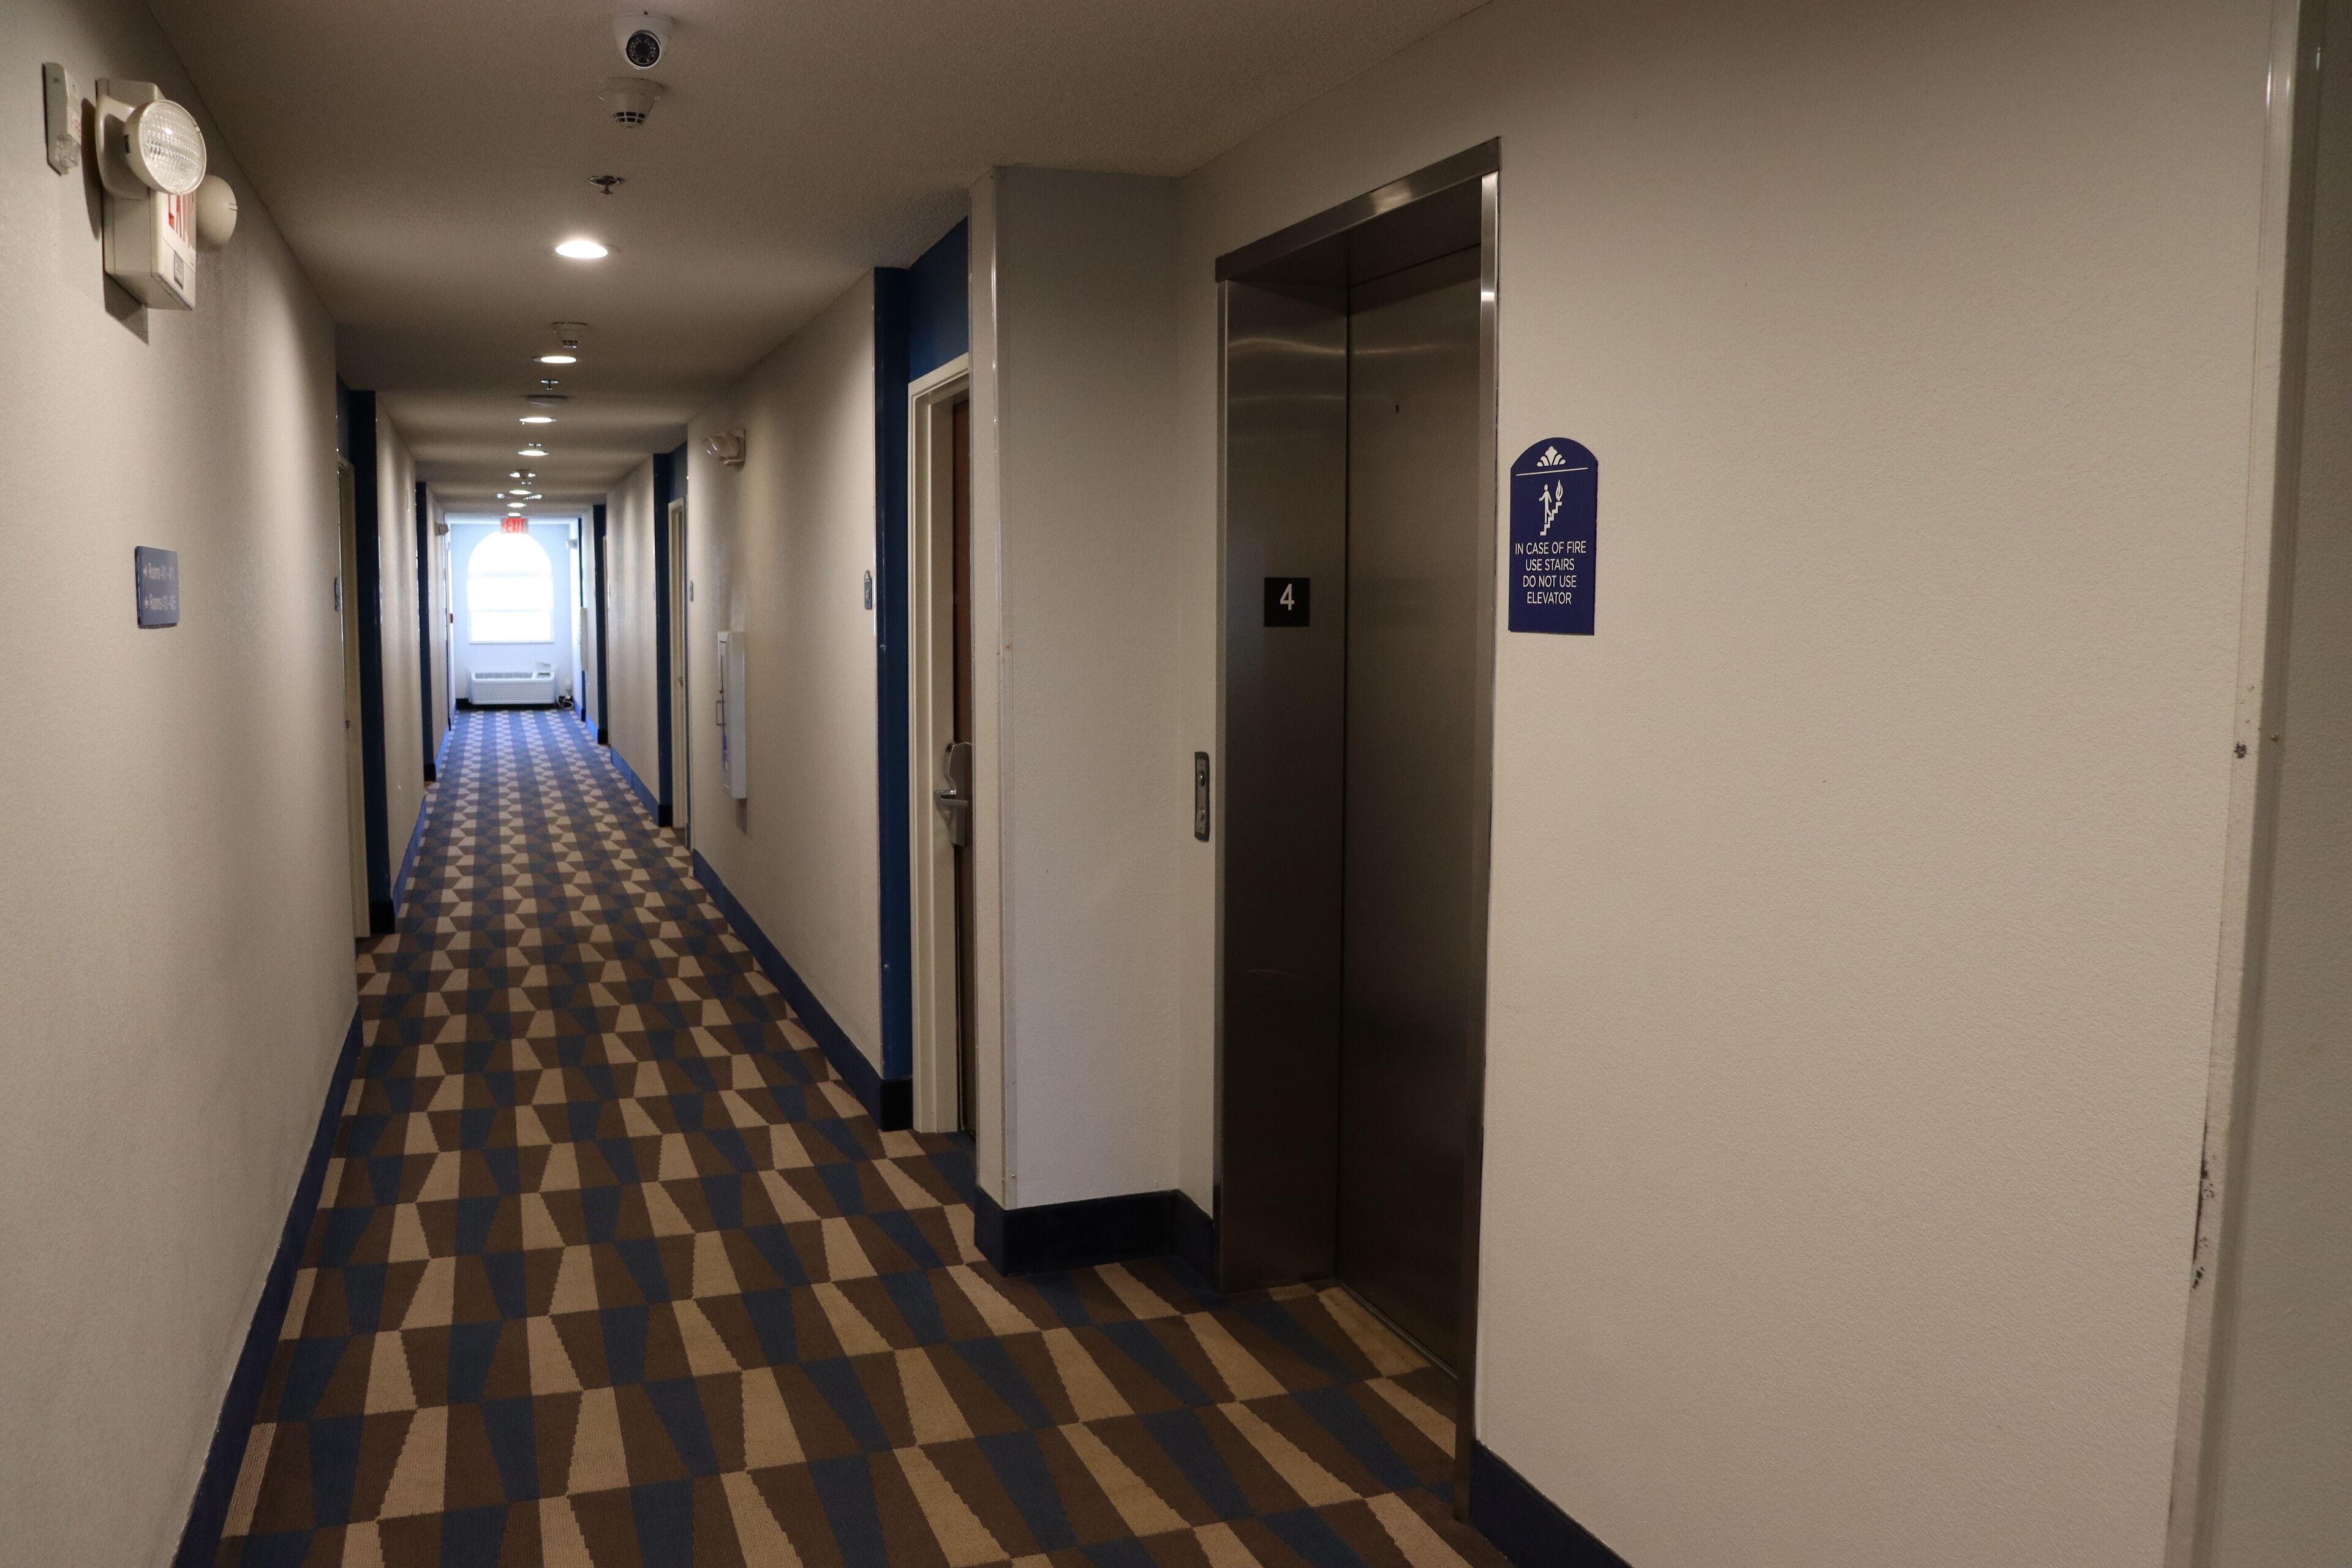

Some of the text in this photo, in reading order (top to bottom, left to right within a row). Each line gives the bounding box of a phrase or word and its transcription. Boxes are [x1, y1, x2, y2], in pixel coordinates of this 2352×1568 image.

[505, 518, 525, 532] EXIT
[1515, 540, 1587, 555] IN CASE OF FIRE
[1525, 558, 1575, 571] USE STAIRS
[1523, 575, 1577, 588] DO NOT USE
[1280, 583, 1295, 611] 4
[1527, 591, 1572, 605] ELEVATOR
